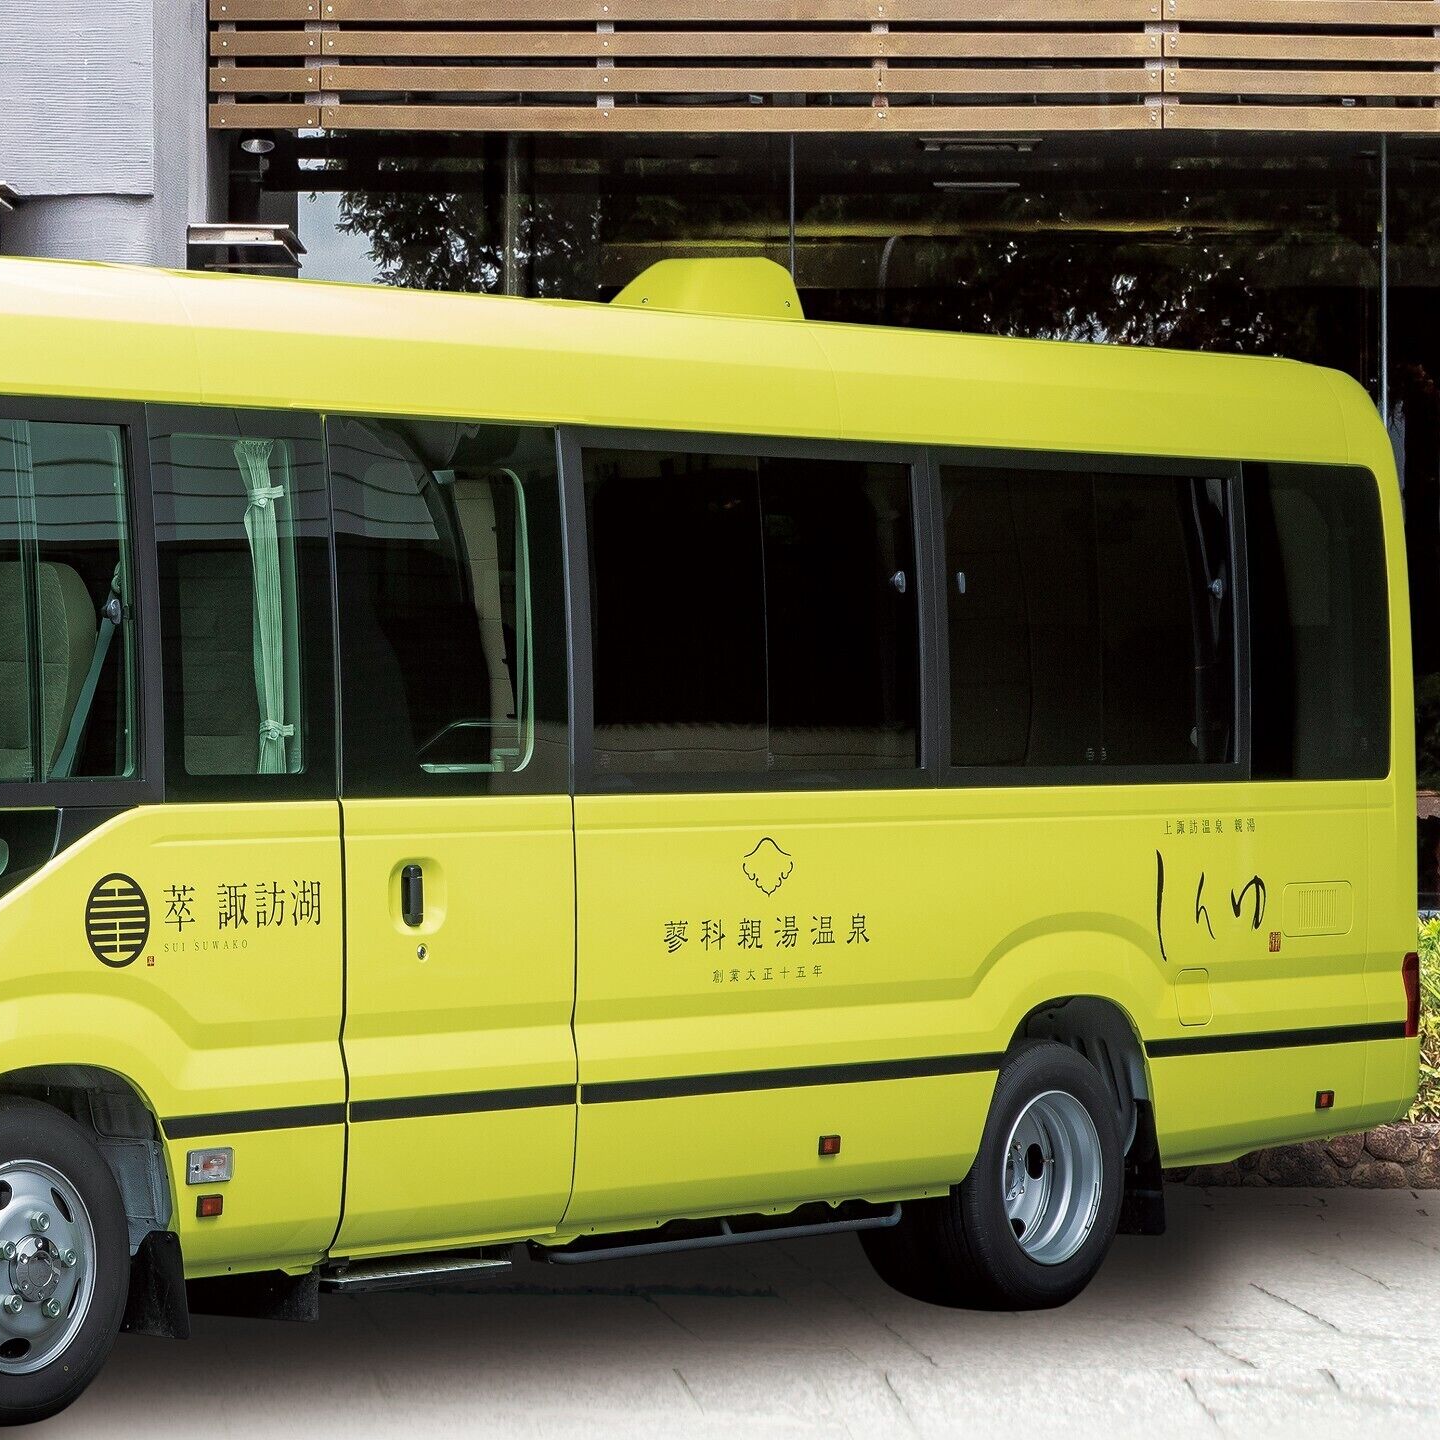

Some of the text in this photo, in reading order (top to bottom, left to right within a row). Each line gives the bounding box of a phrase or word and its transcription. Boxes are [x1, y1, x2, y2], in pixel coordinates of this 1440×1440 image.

[1163, 819, 1223, 835] 上諏訪温泉
[163, 879, 321, 932] 萃 諏訪湖
[1155, 848, 1266, 962] しんゆ
[164, 939, 249, 953] SUI SUWAKO
[663, 912, 870, 954] 蓼科親湯温泉
[712, 964, 823, 984] 創業大正十五年
